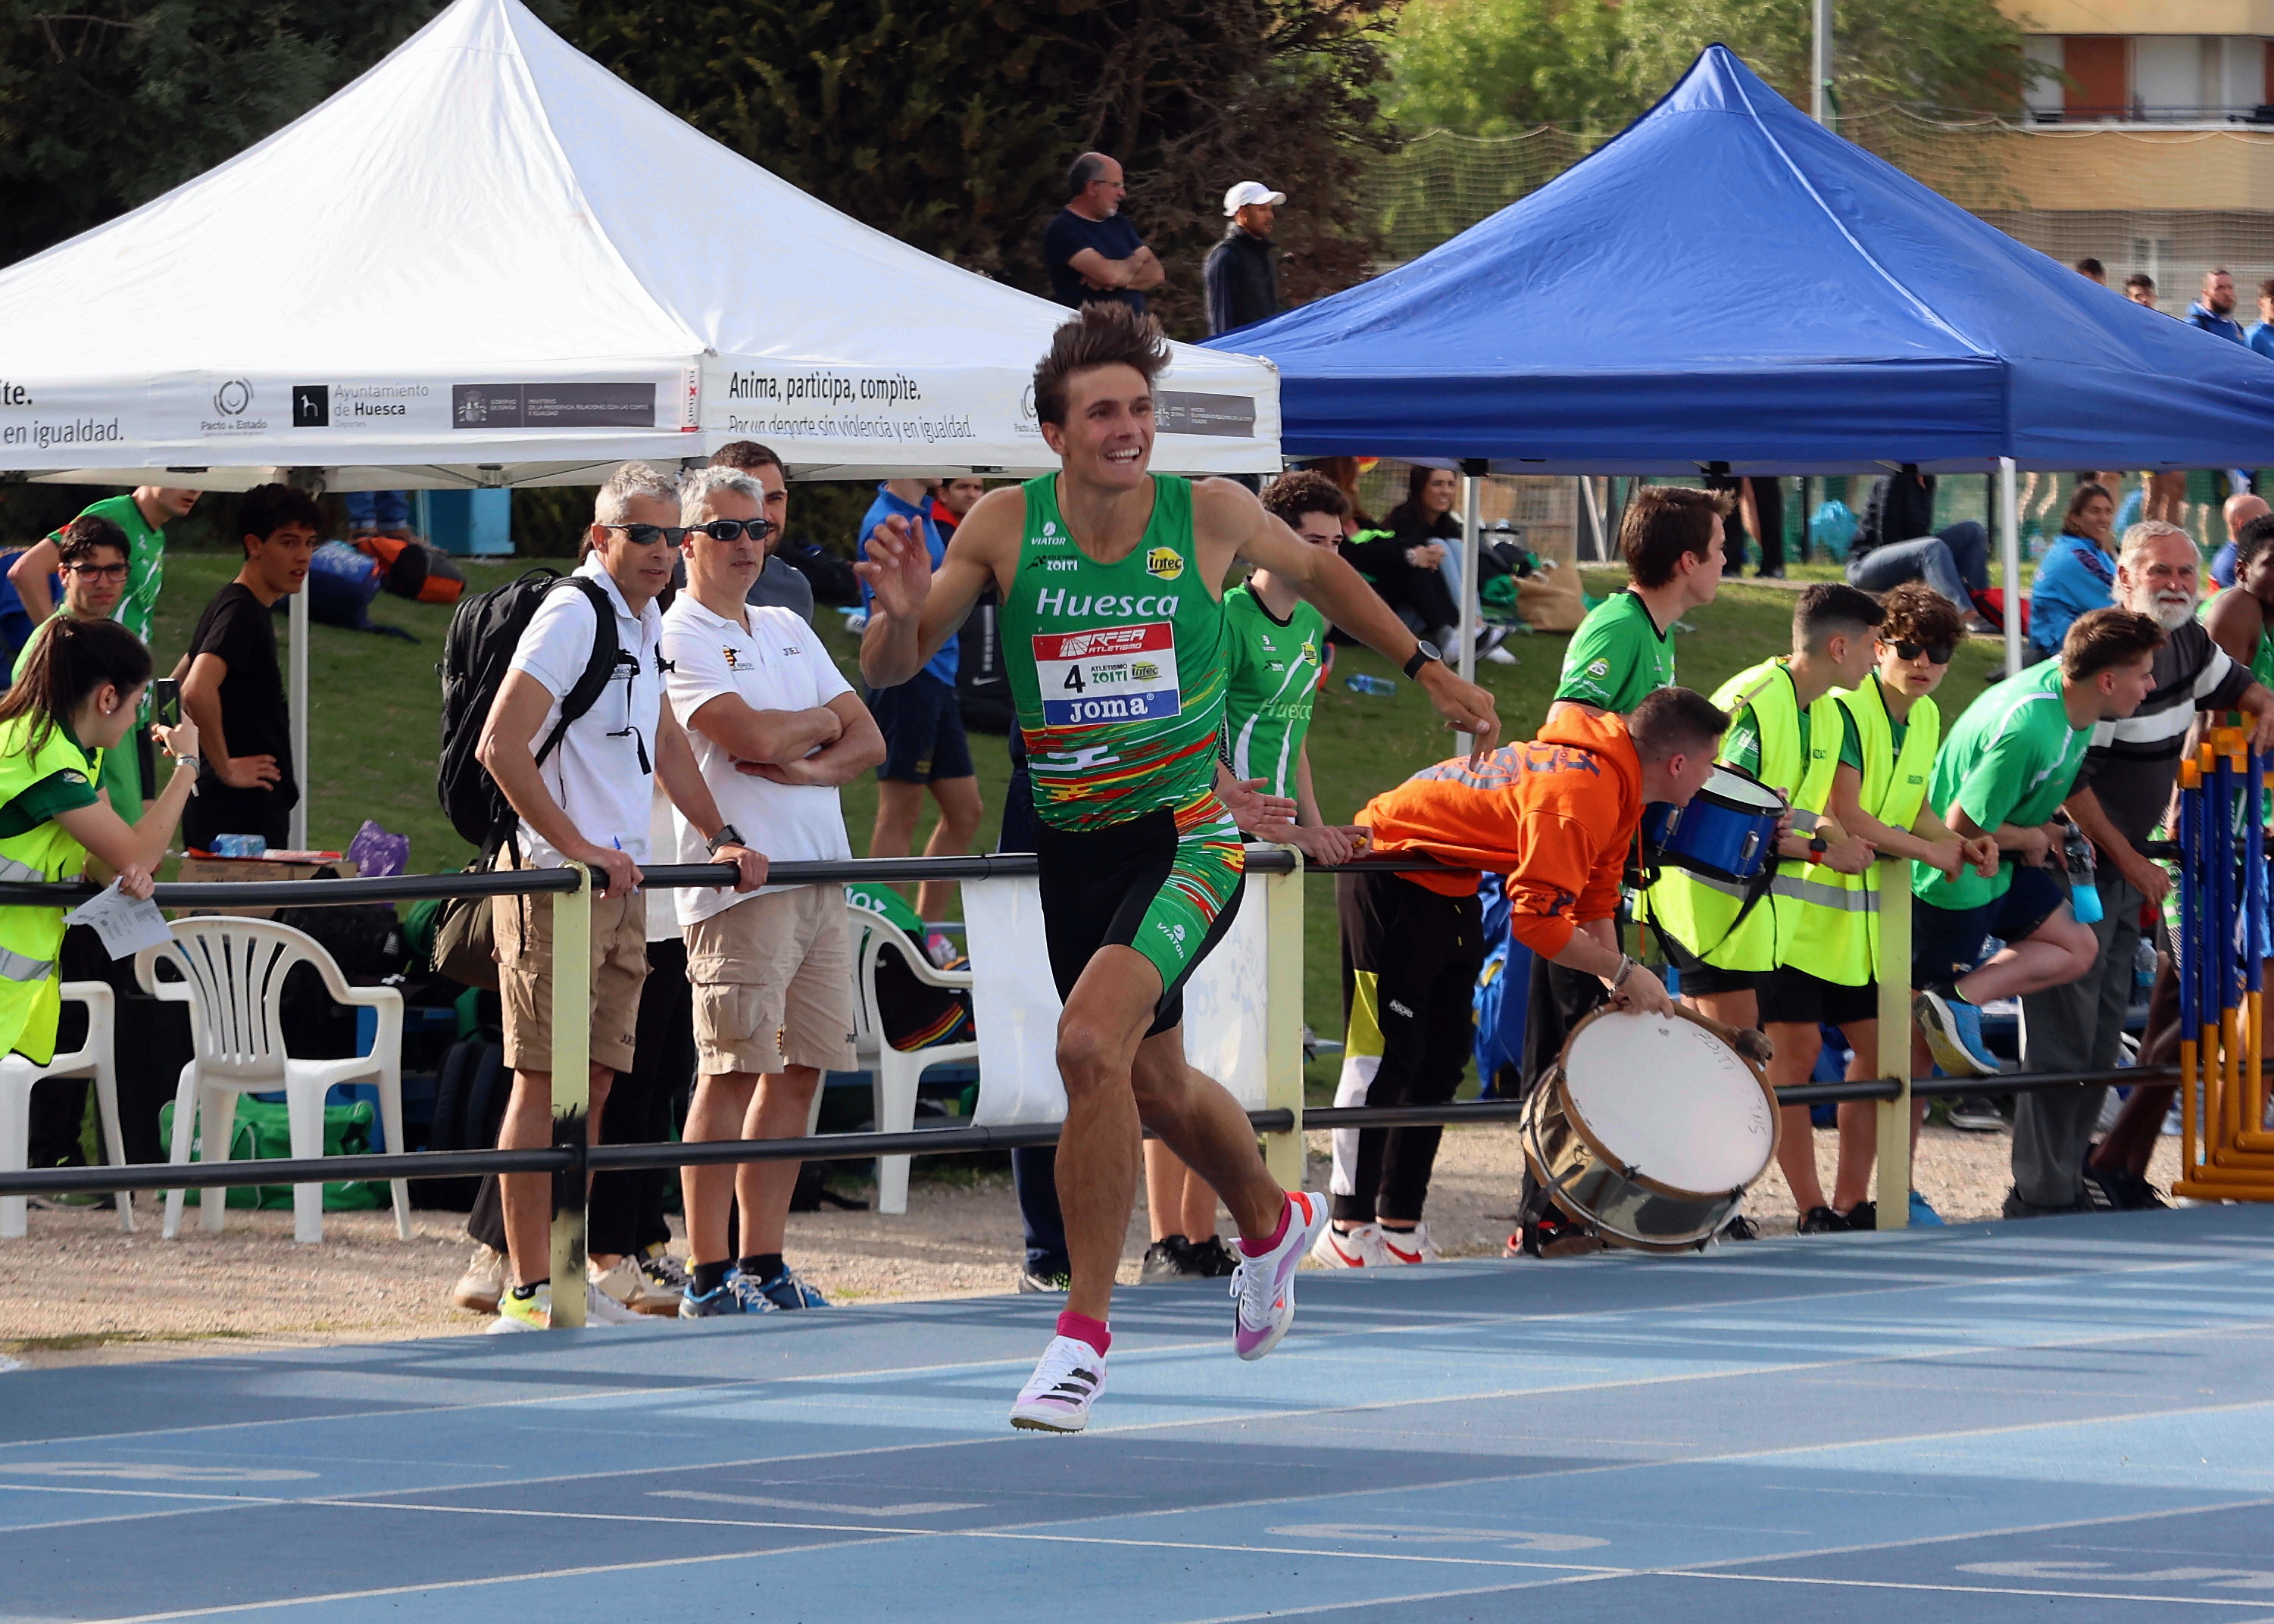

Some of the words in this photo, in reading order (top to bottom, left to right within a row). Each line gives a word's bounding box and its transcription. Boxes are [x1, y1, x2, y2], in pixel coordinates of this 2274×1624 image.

[0, 381, 33, 405] te.
[334, 383, 429, 402] Ayuntamiento
[729, 371, 782, 402] Anima,
[787, 371, 855, 406] participa,
[861, 373, 921, 407] compite.
[334, 402, 351, 417] de
[355, 401, 406, 417] Huesca
[4, 426, 27, 444] en
[33, 417, 124, 449] igualdad.
[729, 415, 749, 433] Por
[768, 414, 816, 439] deporte
[818, 415, 836, 436] sin
[837, 415, 892, 438] violencia
[891, 422, 901, 443] y
[904, 421, 920, 438] en
[919, 415, 976, 444] igualdad.
[1031, 536, 1067, 545] VIATOR
[1046, 559, 1078, 571] ZOITI
[1036, 588, 1179, 617] Huesca
[1090, 629, 1147, 646] RFEA
[1088, 642, 1142, 654] ATLETISMO
[1090, 664, 1128, 673] ATLETISMO
[1092, 670, 1128, 684] ZOITI
[1064, 664, 1086, 694] 4
[1157, 922, 1185, 960] VIATOR
